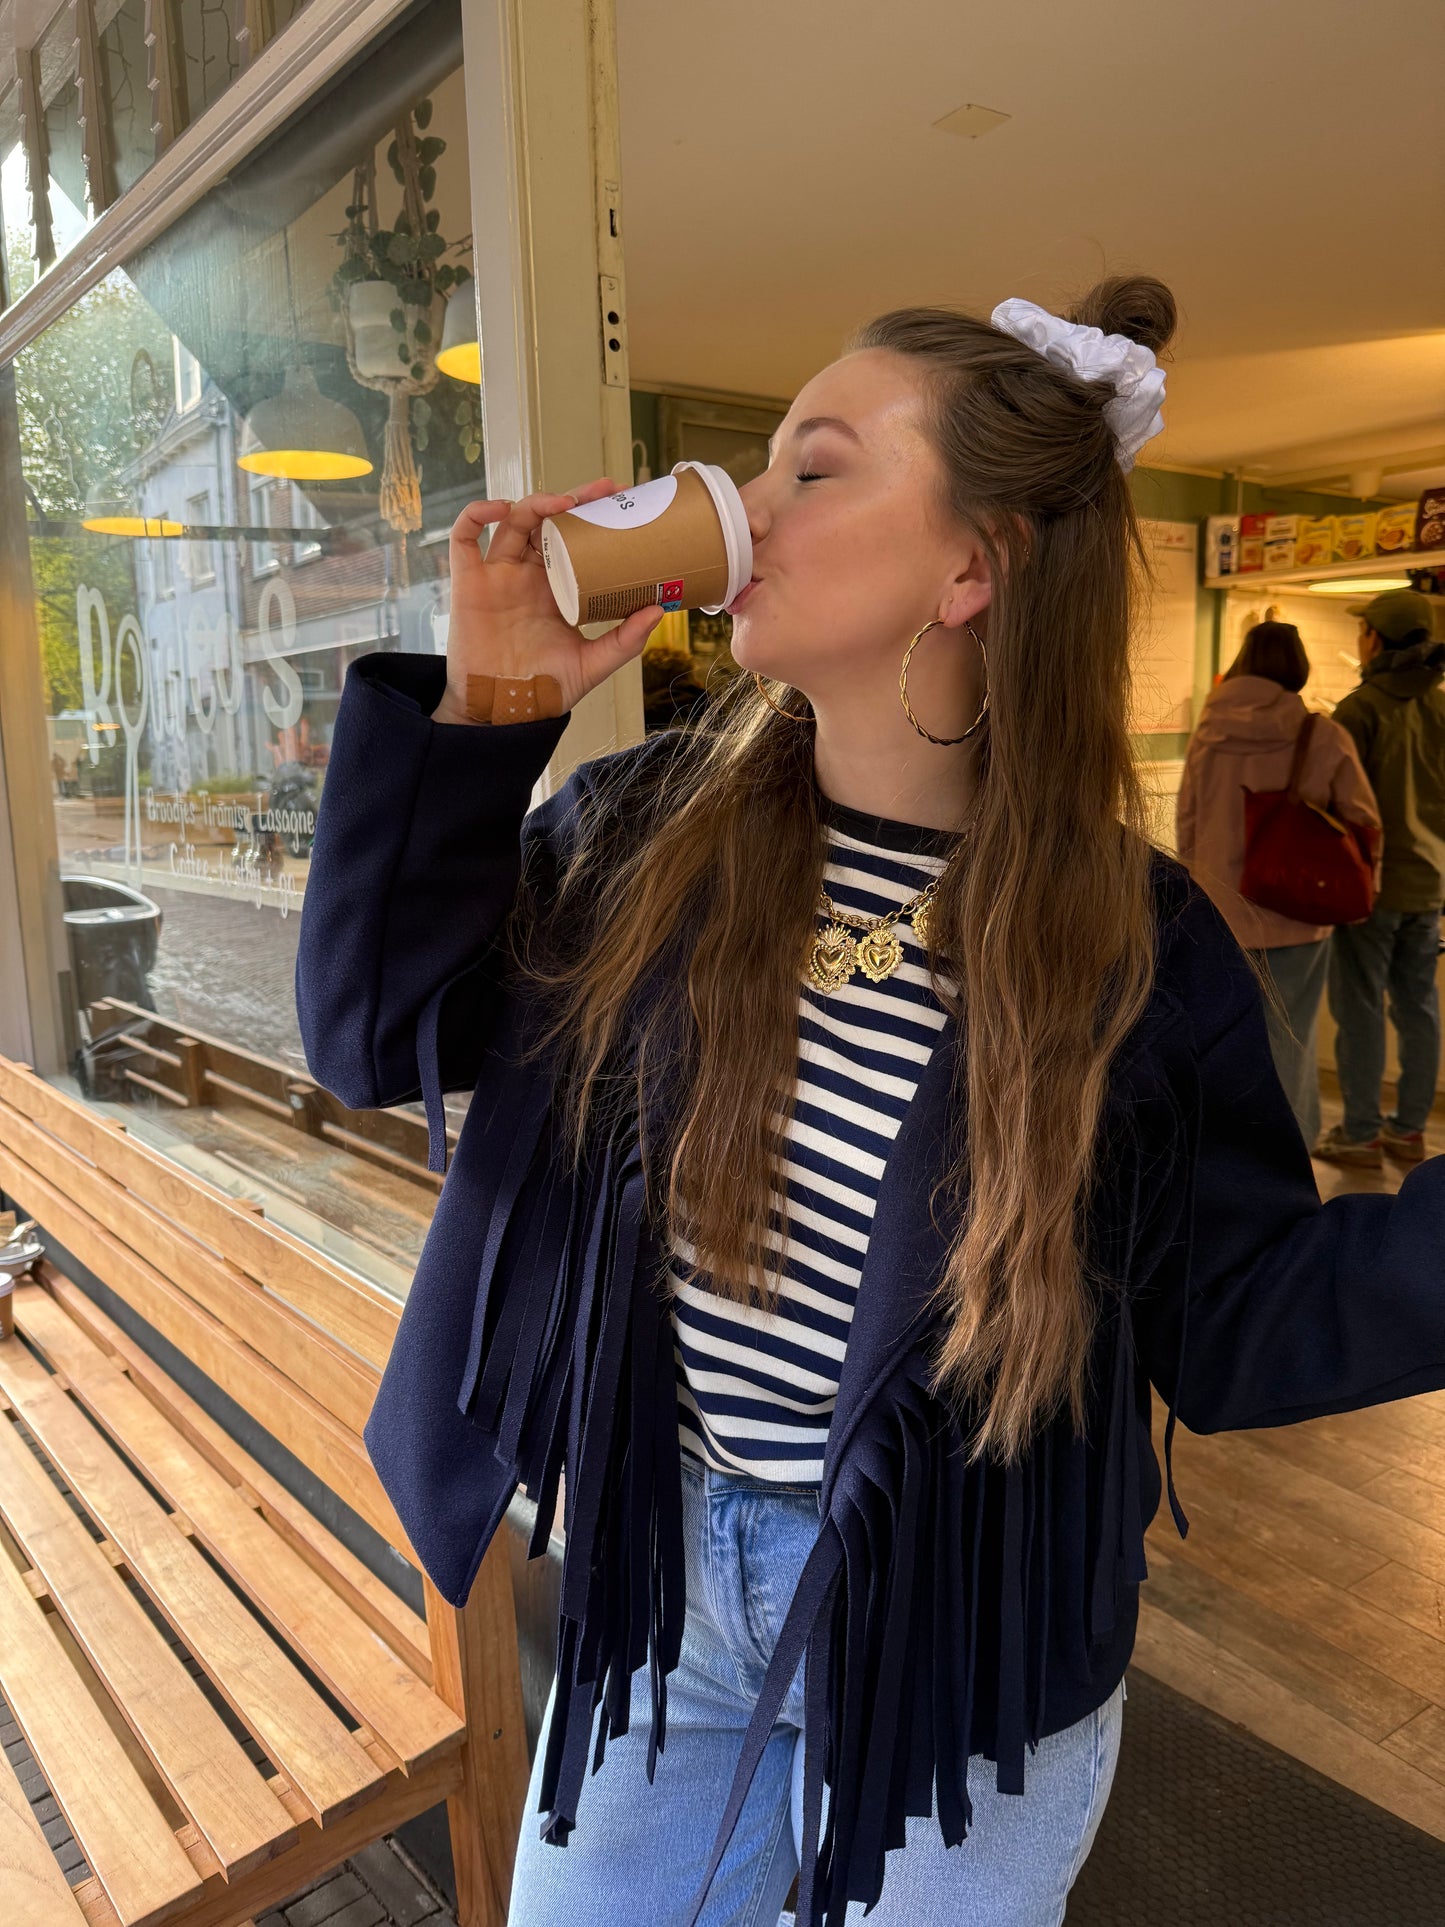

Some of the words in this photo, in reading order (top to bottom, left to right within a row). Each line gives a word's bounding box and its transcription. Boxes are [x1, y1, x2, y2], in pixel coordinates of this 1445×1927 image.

[147, 787, 196, 842] Broodjes
[256, 793, 315, 853] Lasagne
[170, 842, 209, 879] Coffee
